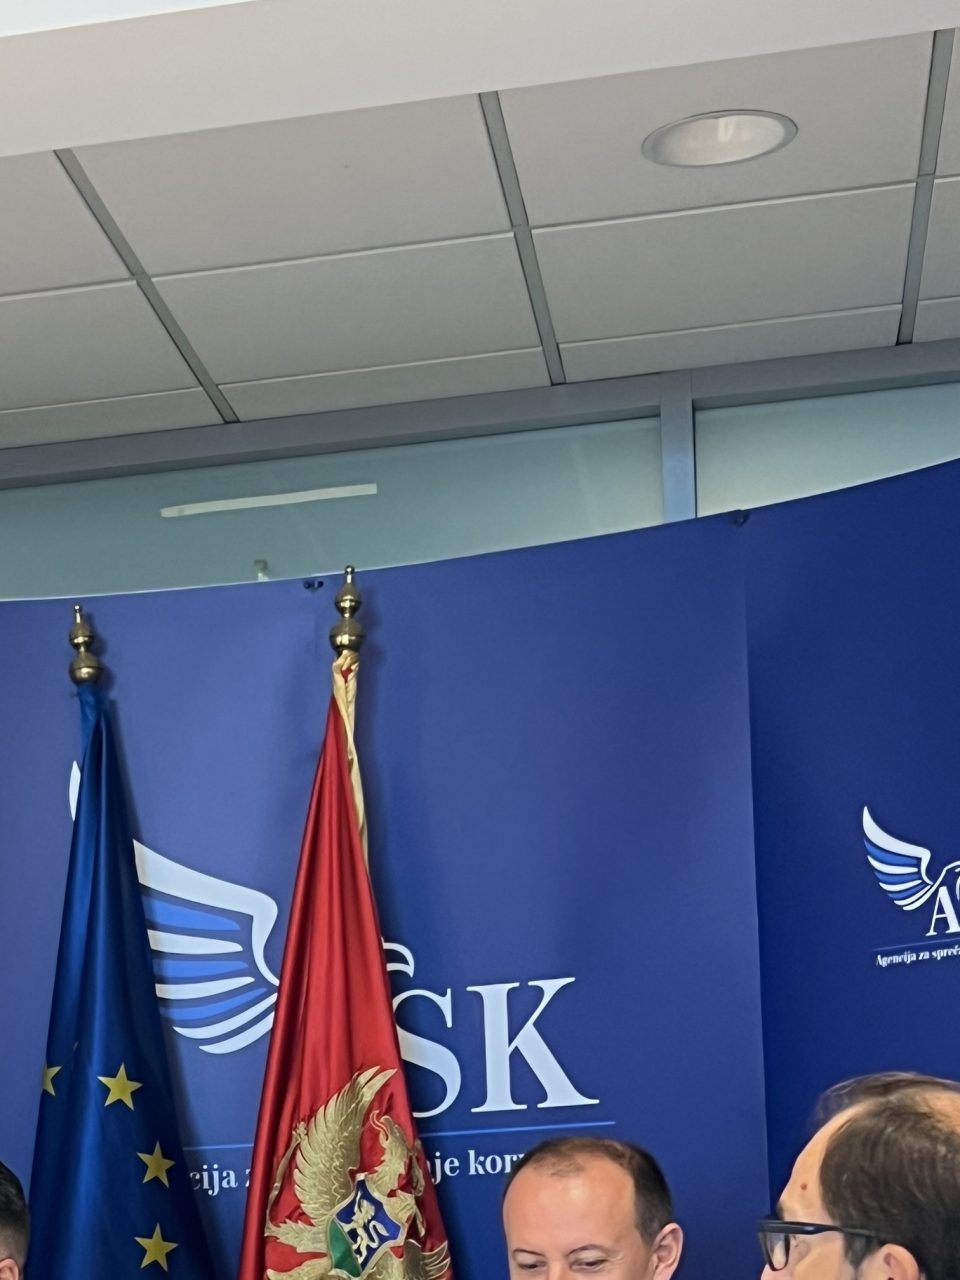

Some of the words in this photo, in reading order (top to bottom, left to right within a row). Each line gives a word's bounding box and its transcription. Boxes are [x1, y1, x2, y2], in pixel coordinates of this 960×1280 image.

[876, 951, 917, 967] Agencija
[919, 951, 930, 960] za
[392, 976, 600, 1118] SK
[467, 1149, 526, 1176] kor
